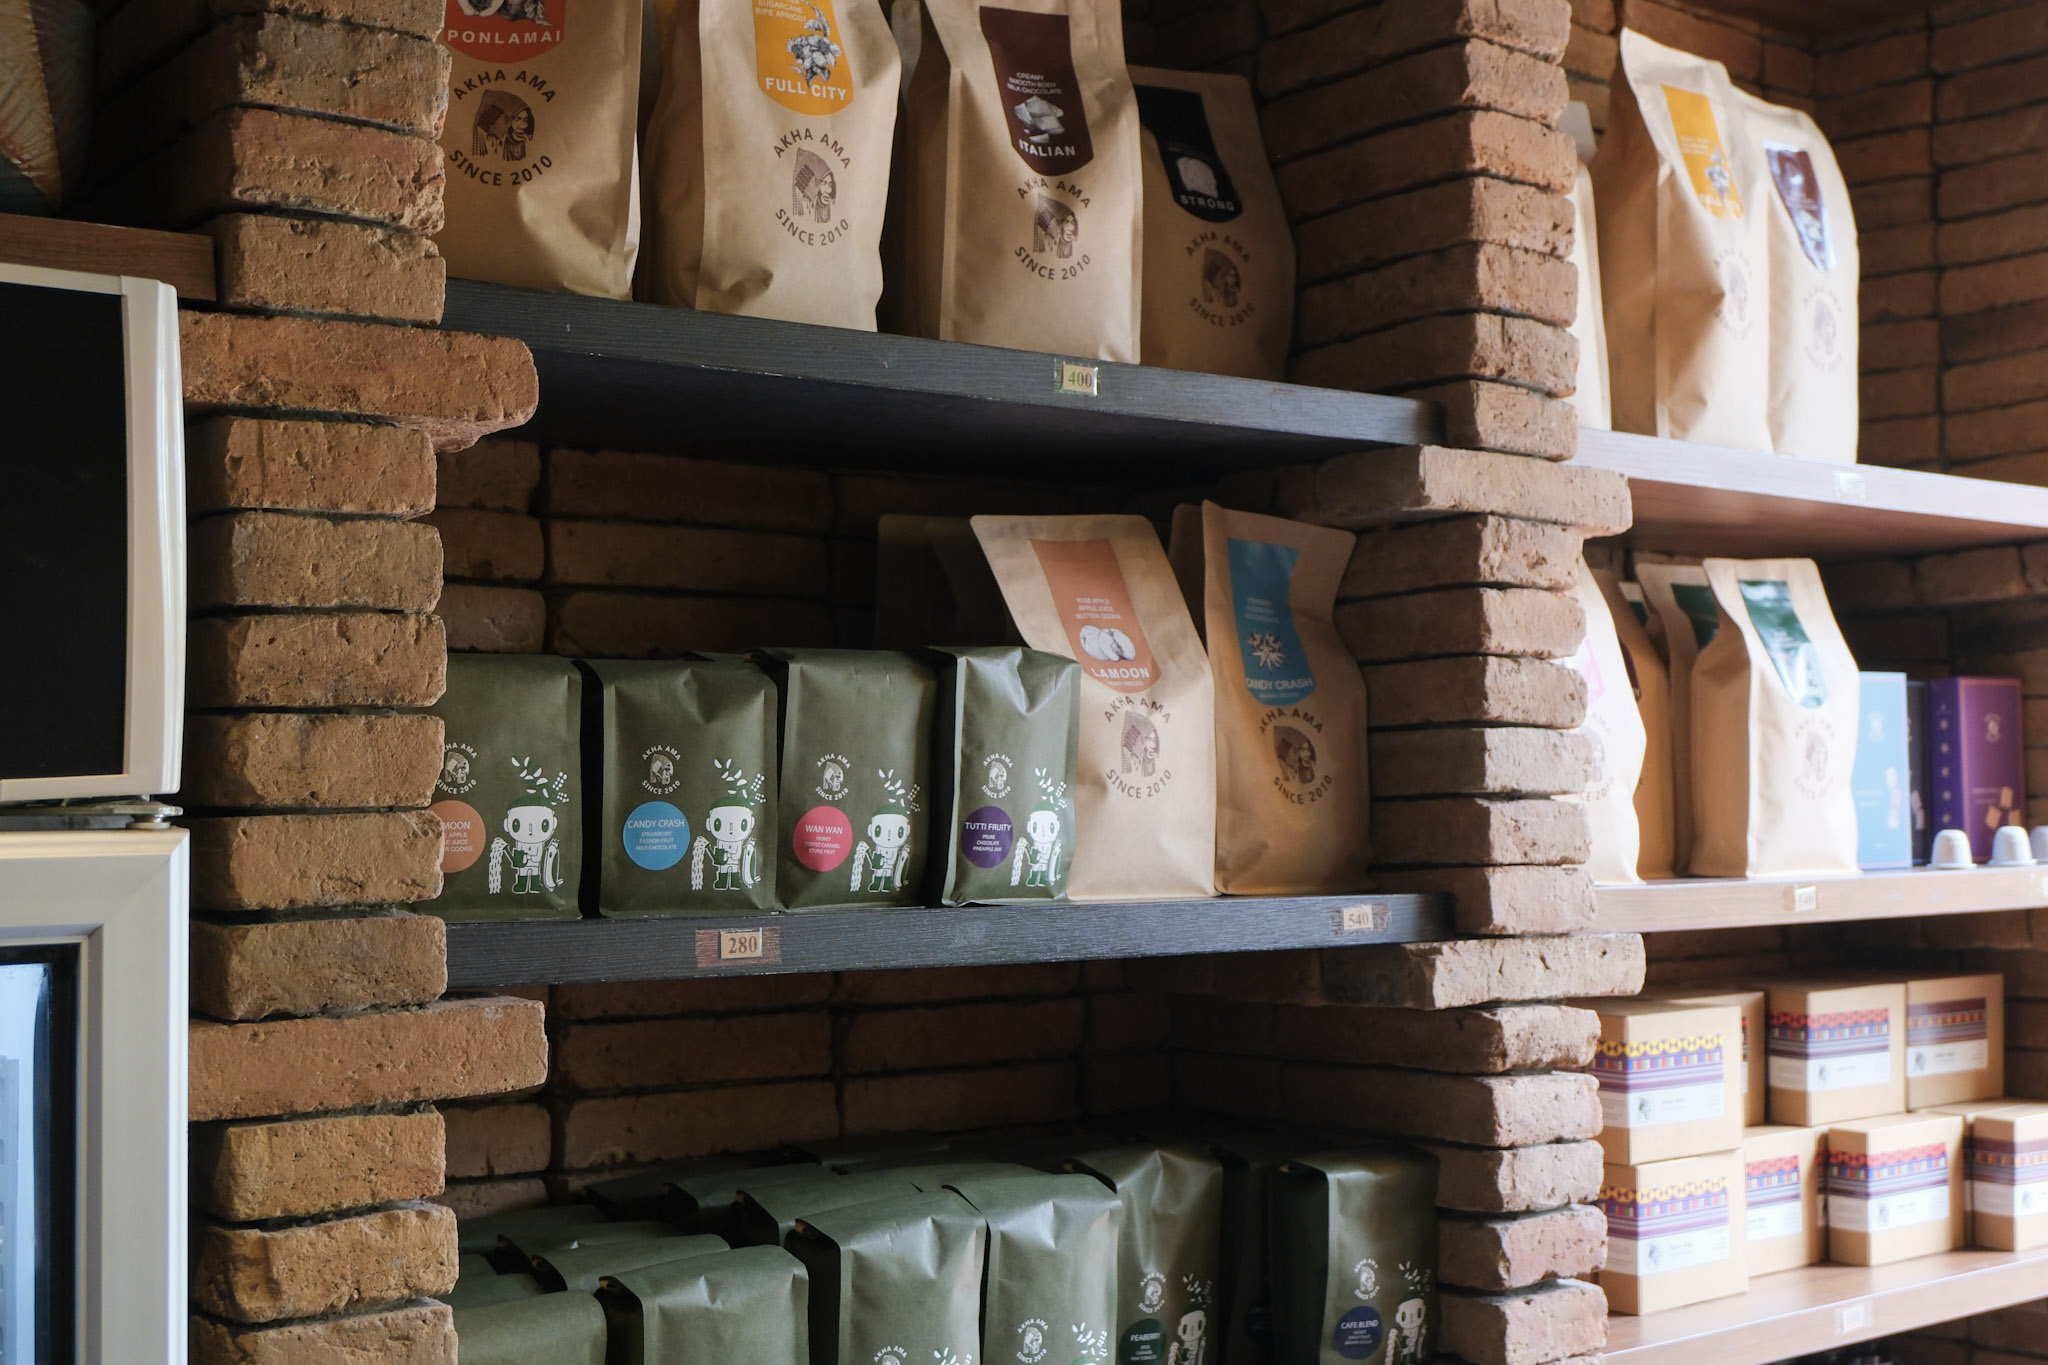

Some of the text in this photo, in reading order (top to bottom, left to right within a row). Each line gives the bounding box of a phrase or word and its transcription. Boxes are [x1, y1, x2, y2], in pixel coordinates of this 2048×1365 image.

[447, 29, 561, 44] PONLAMAI
[453, 69, 556, 103] AKHA AMA
[765, 77, 847, 101] FULL CITY
[773, 128, 851, 169] AKHA AMA
[1018, 138, 1077, 157] ITALIAN
[449, 149, 552, 186] SINCE 2010
[1017, 178, 1090, 208] AKHA AMA
[1180, 194, 1235, 212] STRONG
[775, 208, 849, 247] SINCE 2010
[1185, 231, 1250, 264] AKHA AMA
[1014, 246, 1091, 280] SINCE 2010
[1189, 297, 1255, 327] SINCE 2010
[1068, 370, 1093, 388] 400
[1090, 667, 1151, 679] LAMOON
[1246, 677, 1314, 691] CANDY CRASH
[1104, 695, 1172, 724] AKHA AMA
[1260, 707, 1323, 736] AKHA AMA
[460, 743, 478, 759] AMA
[642, 744, 681, 761] AKHA AMA
[816, 752, 851, 769] AKHA AMA
[983, 752, 1013, 768] AKHA AMA
[436, 779, 477, 795] SINCE 2010
[641, 780, 681, 795] SINCE 2010
[981, 784, 1011, 799] SINCE 2010
[1106, 768, 1173, 799] SINCE 2010
[1273, 775, 1333, 805] SINCE 2010
[815, 786, 849, 801] SINCE 2010
[441, 821, 471, 830] MOON
[627, 819, 685, 829] CANDY CRASH
[805, 824, 843, 835] WAN WAN
[964, 821, 1012, 831] TUTTI FRUITY
[1348, 911, 1369, 928] 540
[728, 935, 758, 954] 280
[1017, 1317, 1049, 1334] AKHA AMA
[1340, 1319, 1379, 1330] CAFE BLEND
[1130, 1332, 1161, 1342] PEABERRY
[873, 1345, 908, 1363] AKHA AMA
[1016, 1348, 1047, 1364] SINCE 2010
